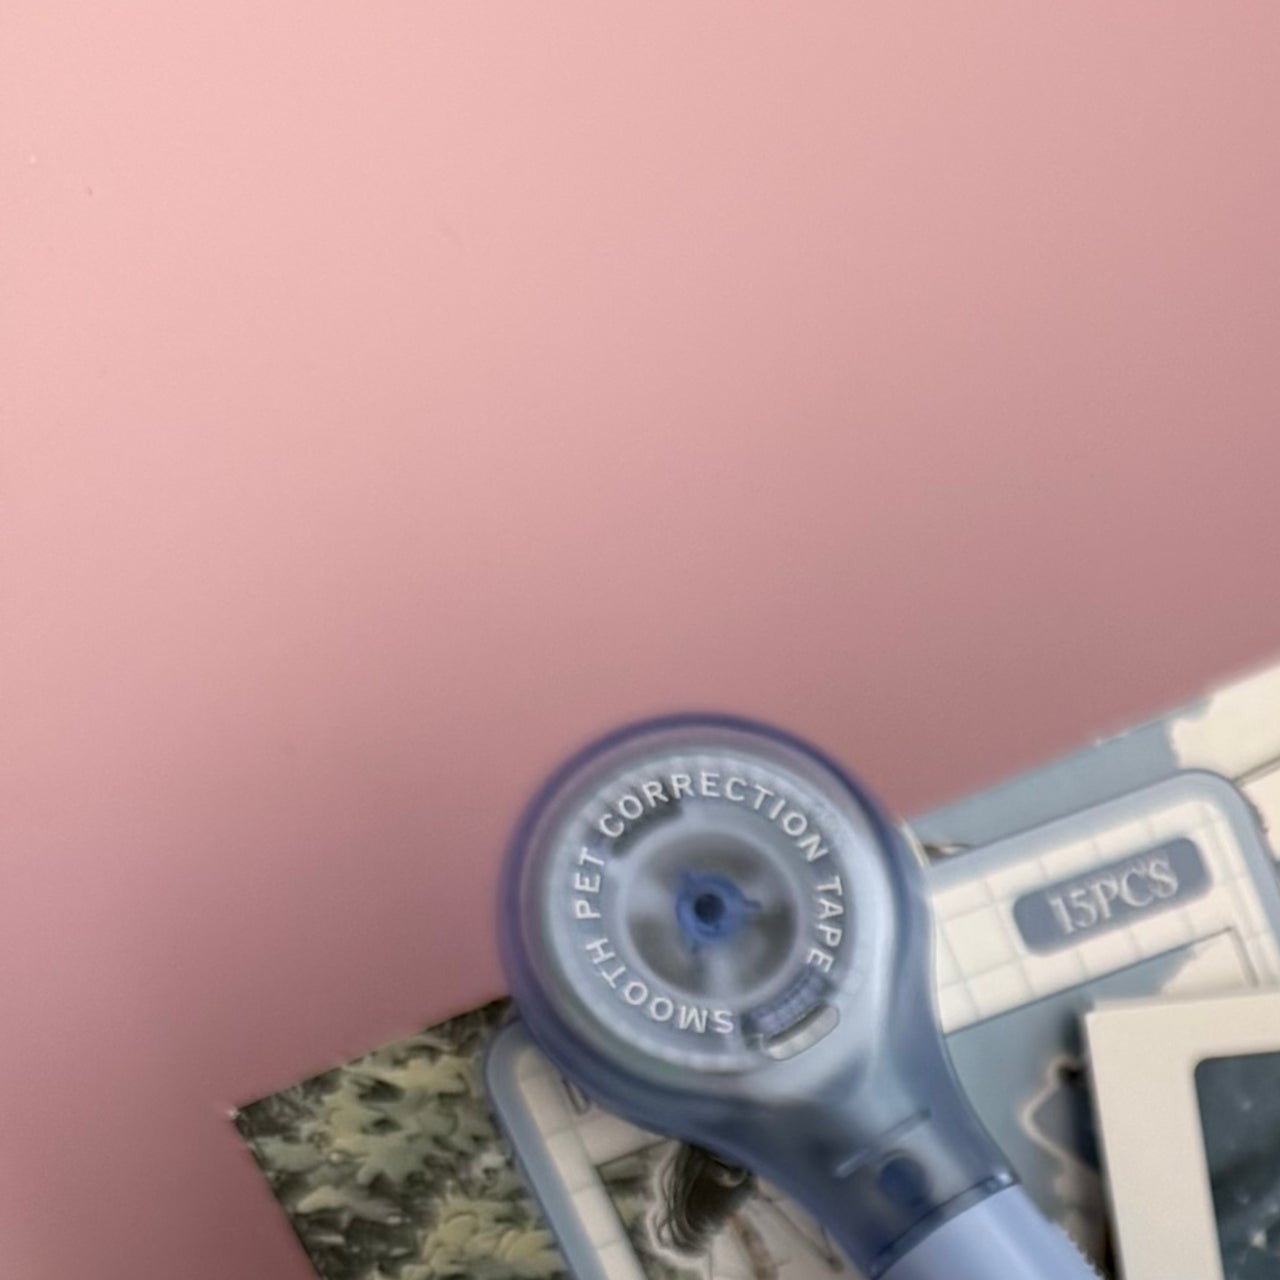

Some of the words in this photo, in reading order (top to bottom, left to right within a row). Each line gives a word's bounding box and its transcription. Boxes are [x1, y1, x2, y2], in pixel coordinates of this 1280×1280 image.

[600, 772, 829, 862] CORRECTION
[574, 847, 605, 920] PET
[808, 875, 843, 972] TAPE
[1050, 855, 1179, 936] 15PCS
[585, 938, 734, 1033] SMOOTH
